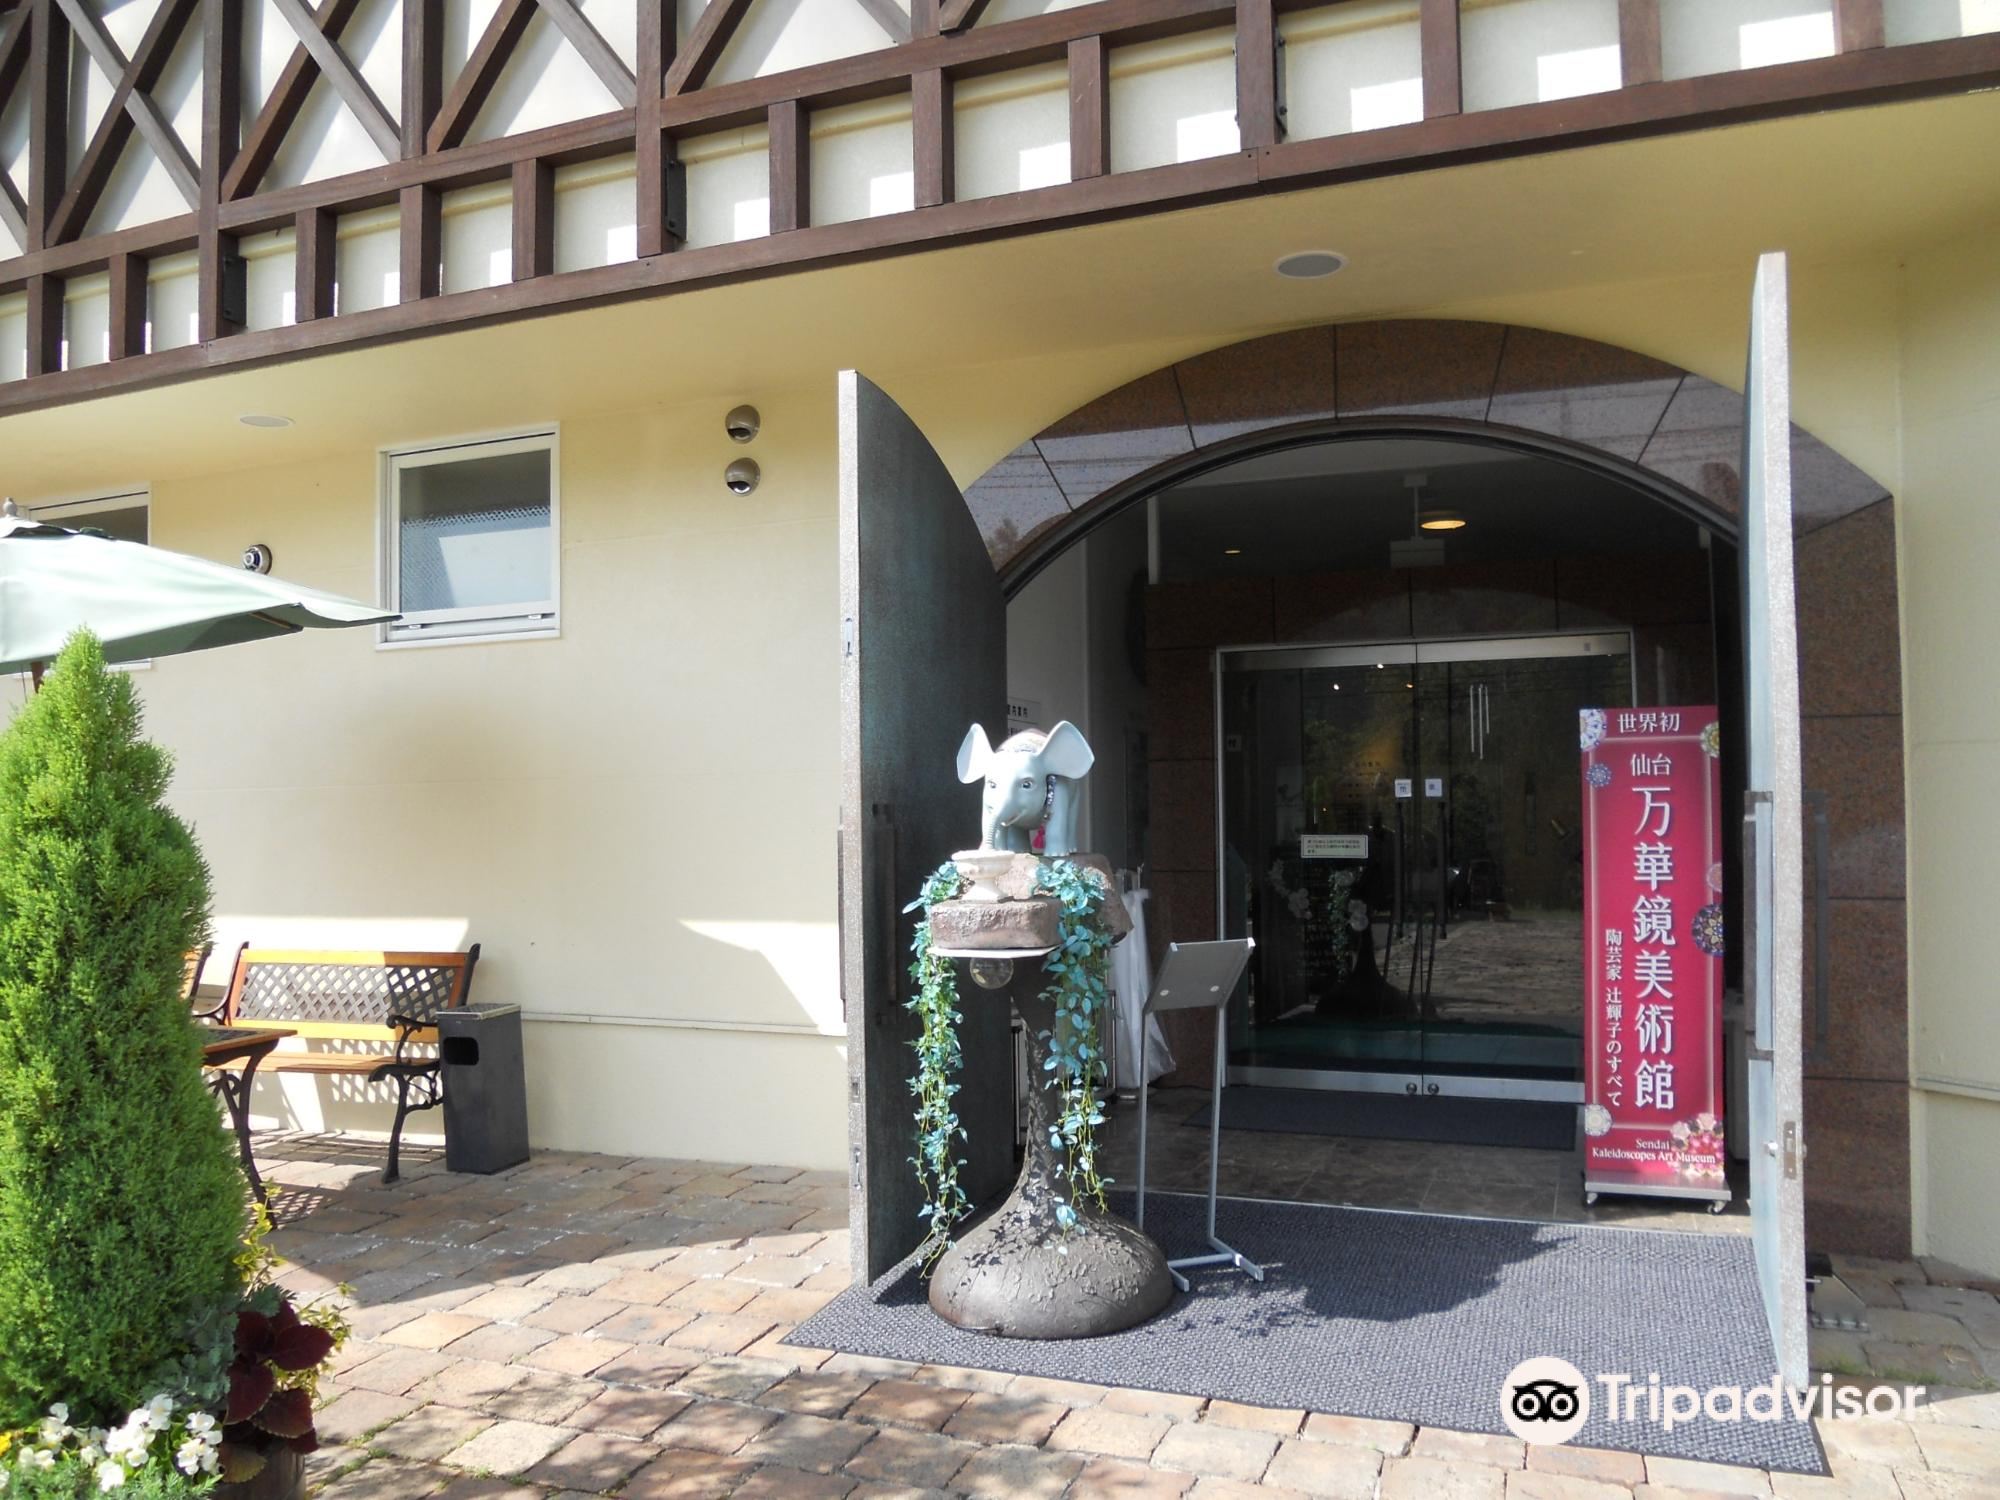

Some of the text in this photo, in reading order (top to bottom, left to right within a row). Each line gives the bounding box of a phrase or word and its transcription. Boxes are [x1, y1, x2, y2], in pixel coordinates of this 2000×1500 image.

[1617, 712, 1681, 733] 世界初
[1630, 752, 1672, 776] 仙台
[1632, 786, 1676, 1110] 万華鏡美術館
[1605, 928, 1624, 1107] 陶芸家 辻輝子のすべて
[1636, 1138, 1670, 1150] Sendai
[1592, 1147, 1716, 1164] Kaleidoscopes Art Museum
